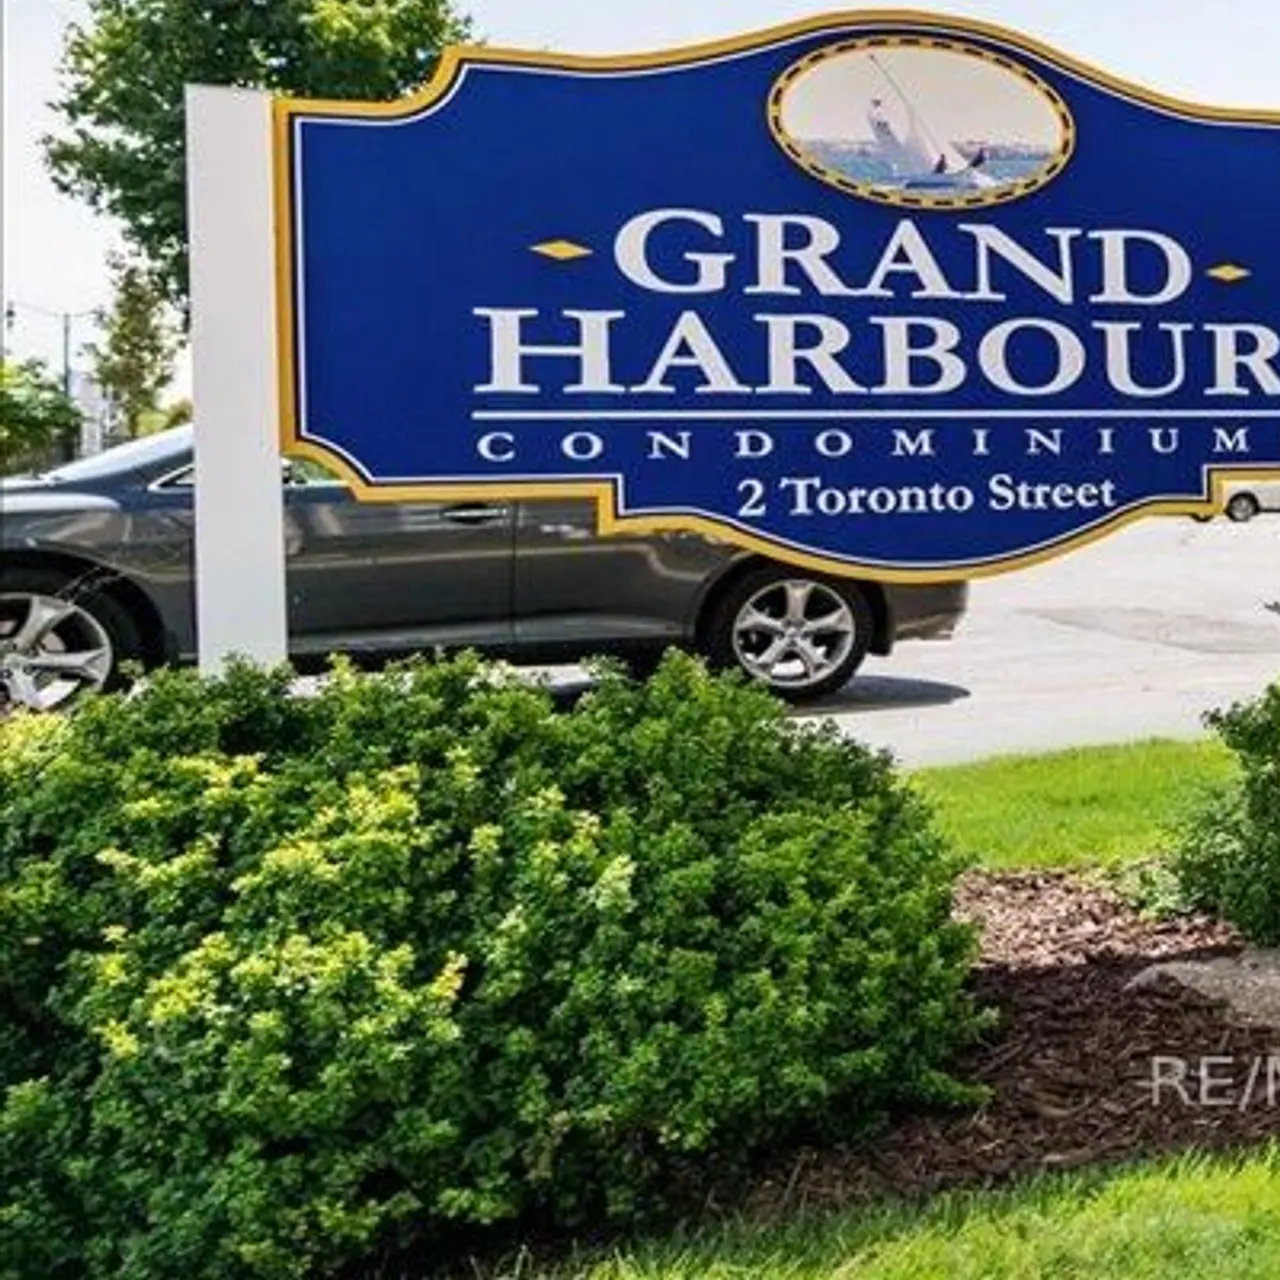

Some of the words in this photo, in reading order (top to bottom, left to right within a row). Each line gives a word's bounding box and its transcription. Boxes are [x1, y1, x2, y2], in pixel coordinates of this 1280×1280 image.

[613, 207, 1193, 305] GRAND
[737, 478, 766, 517] 2
[778, 476, 975, 516] Toronto
[988, 472, 1116, 510] Street
